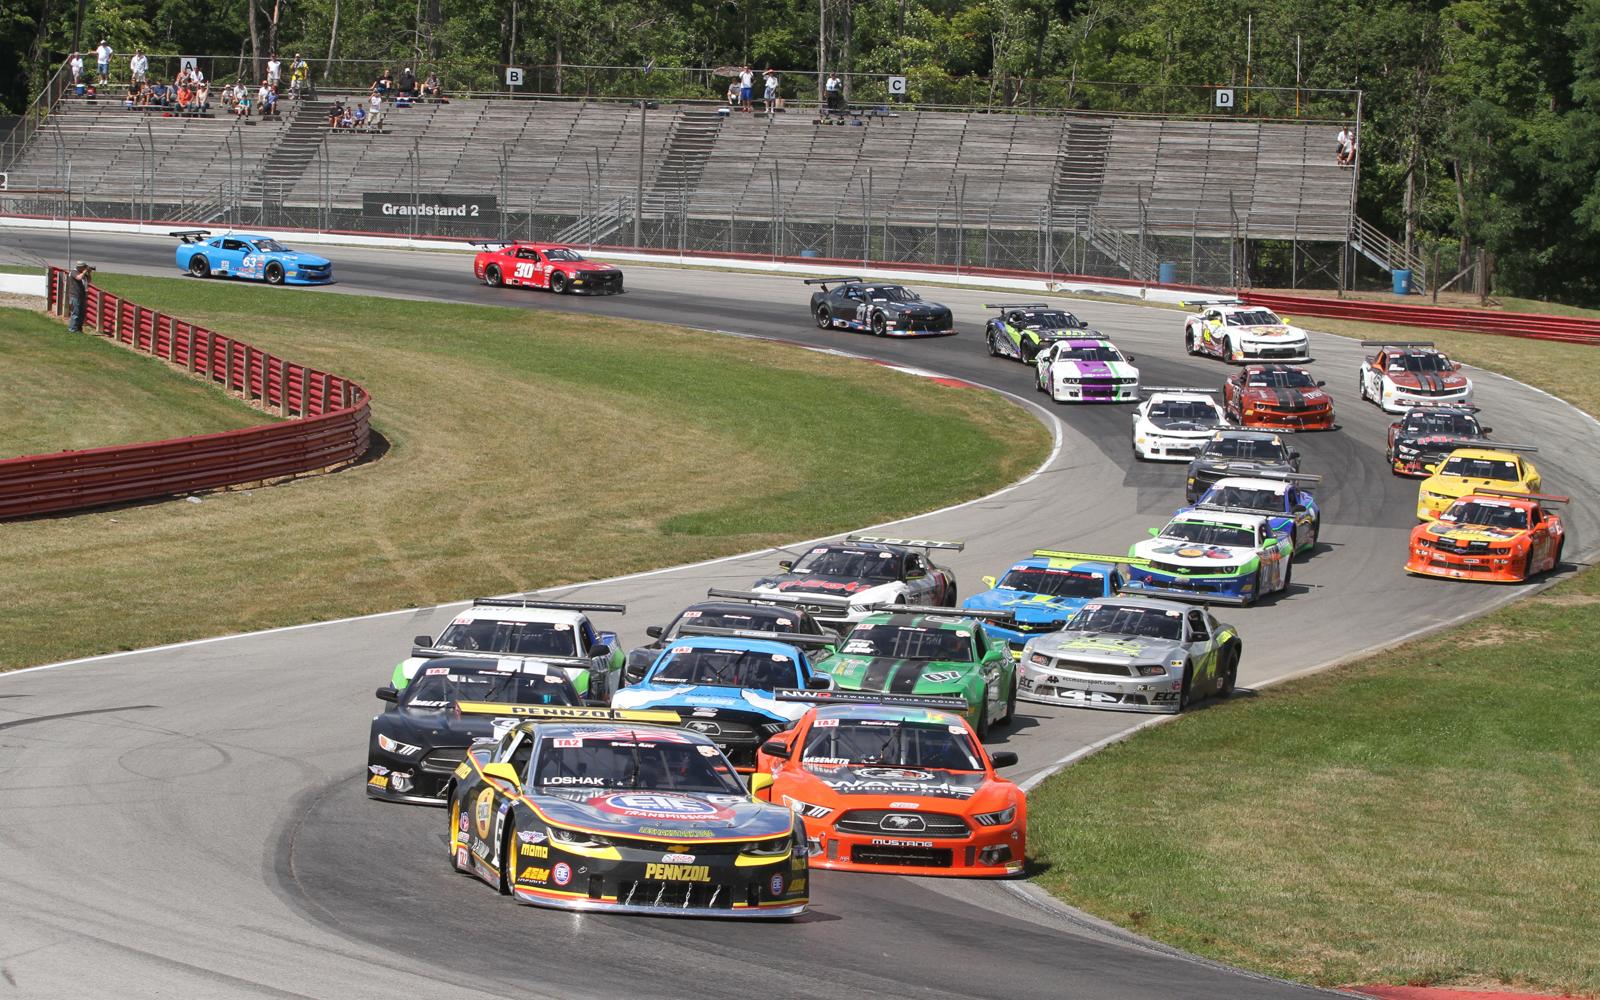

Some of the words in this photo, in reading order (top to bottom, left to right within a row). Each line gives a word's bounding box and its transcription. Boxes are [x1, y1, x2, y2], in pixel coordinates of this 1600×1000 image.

[186, 61, 193, 71] A
[510, 71, 519, 82] B
[892, 80, 902, 91] C
[1220, 93, 1230, 104] D
[382, 203, 466, 216] Grandstand
[470, 204, 480, 217] 2
[243, 256, 257, 268] 63
[513, 262, 535, 279] 30
[782, 690, 831, 698] NWR
[511, 706, 626, 719] PENNZOIL
[543, 777, 604, 786] LOSHAK
[872, 838, 933, 848] MUSTANG
[519, 866, 551, 881] AEM
[644, 862, 712, 882] PENNZOIL
